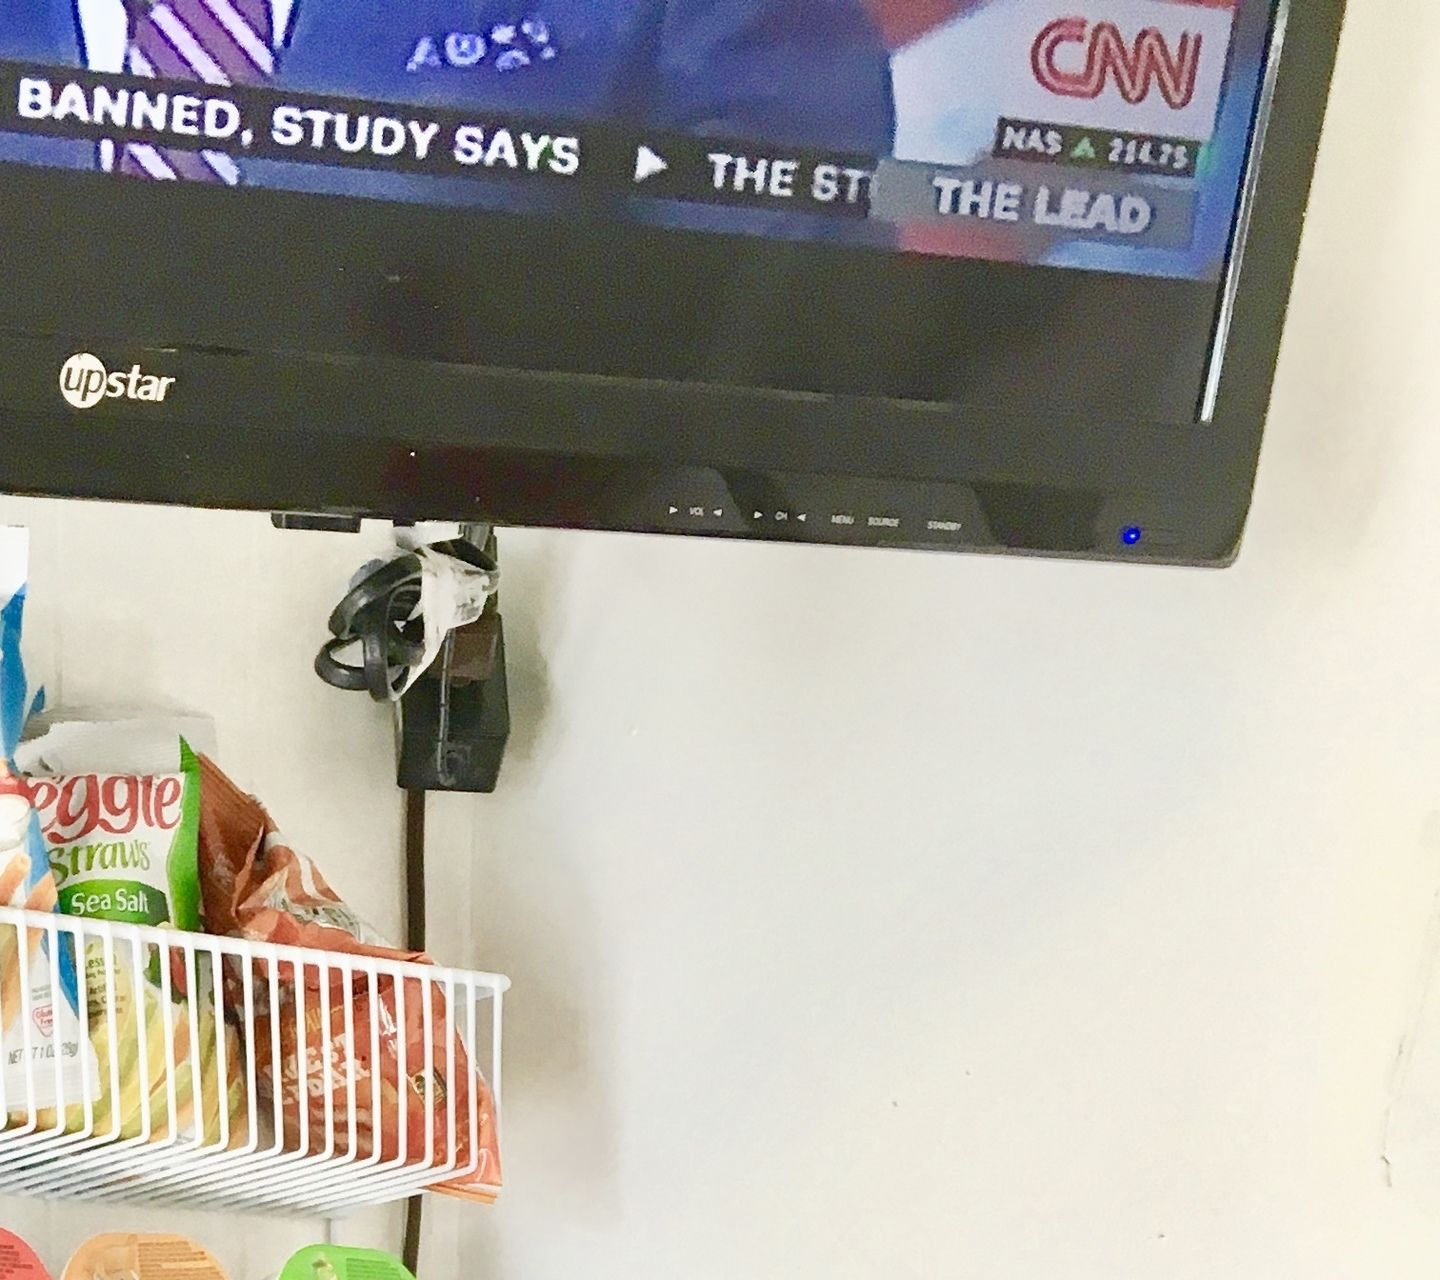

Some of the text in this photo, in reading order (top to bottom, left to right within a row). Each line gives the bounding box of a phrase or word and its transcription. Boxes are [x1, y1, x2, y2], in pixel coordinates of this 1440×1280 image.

[1031, 16, 1203, 110] CNN
[19, 77, 253, 148] BANNED,
[271, 105, 440, 159] STUDY
[453, 125, 580, 176] SAYS
[707, 152, 796, 199] THE
[1002, 126, 1062, 155] NAS
[932, 175, 1152, 235] THE LEAD
[59, 352, 177, 409] upstar
[70, 887, 151, 916] Sea Salt
